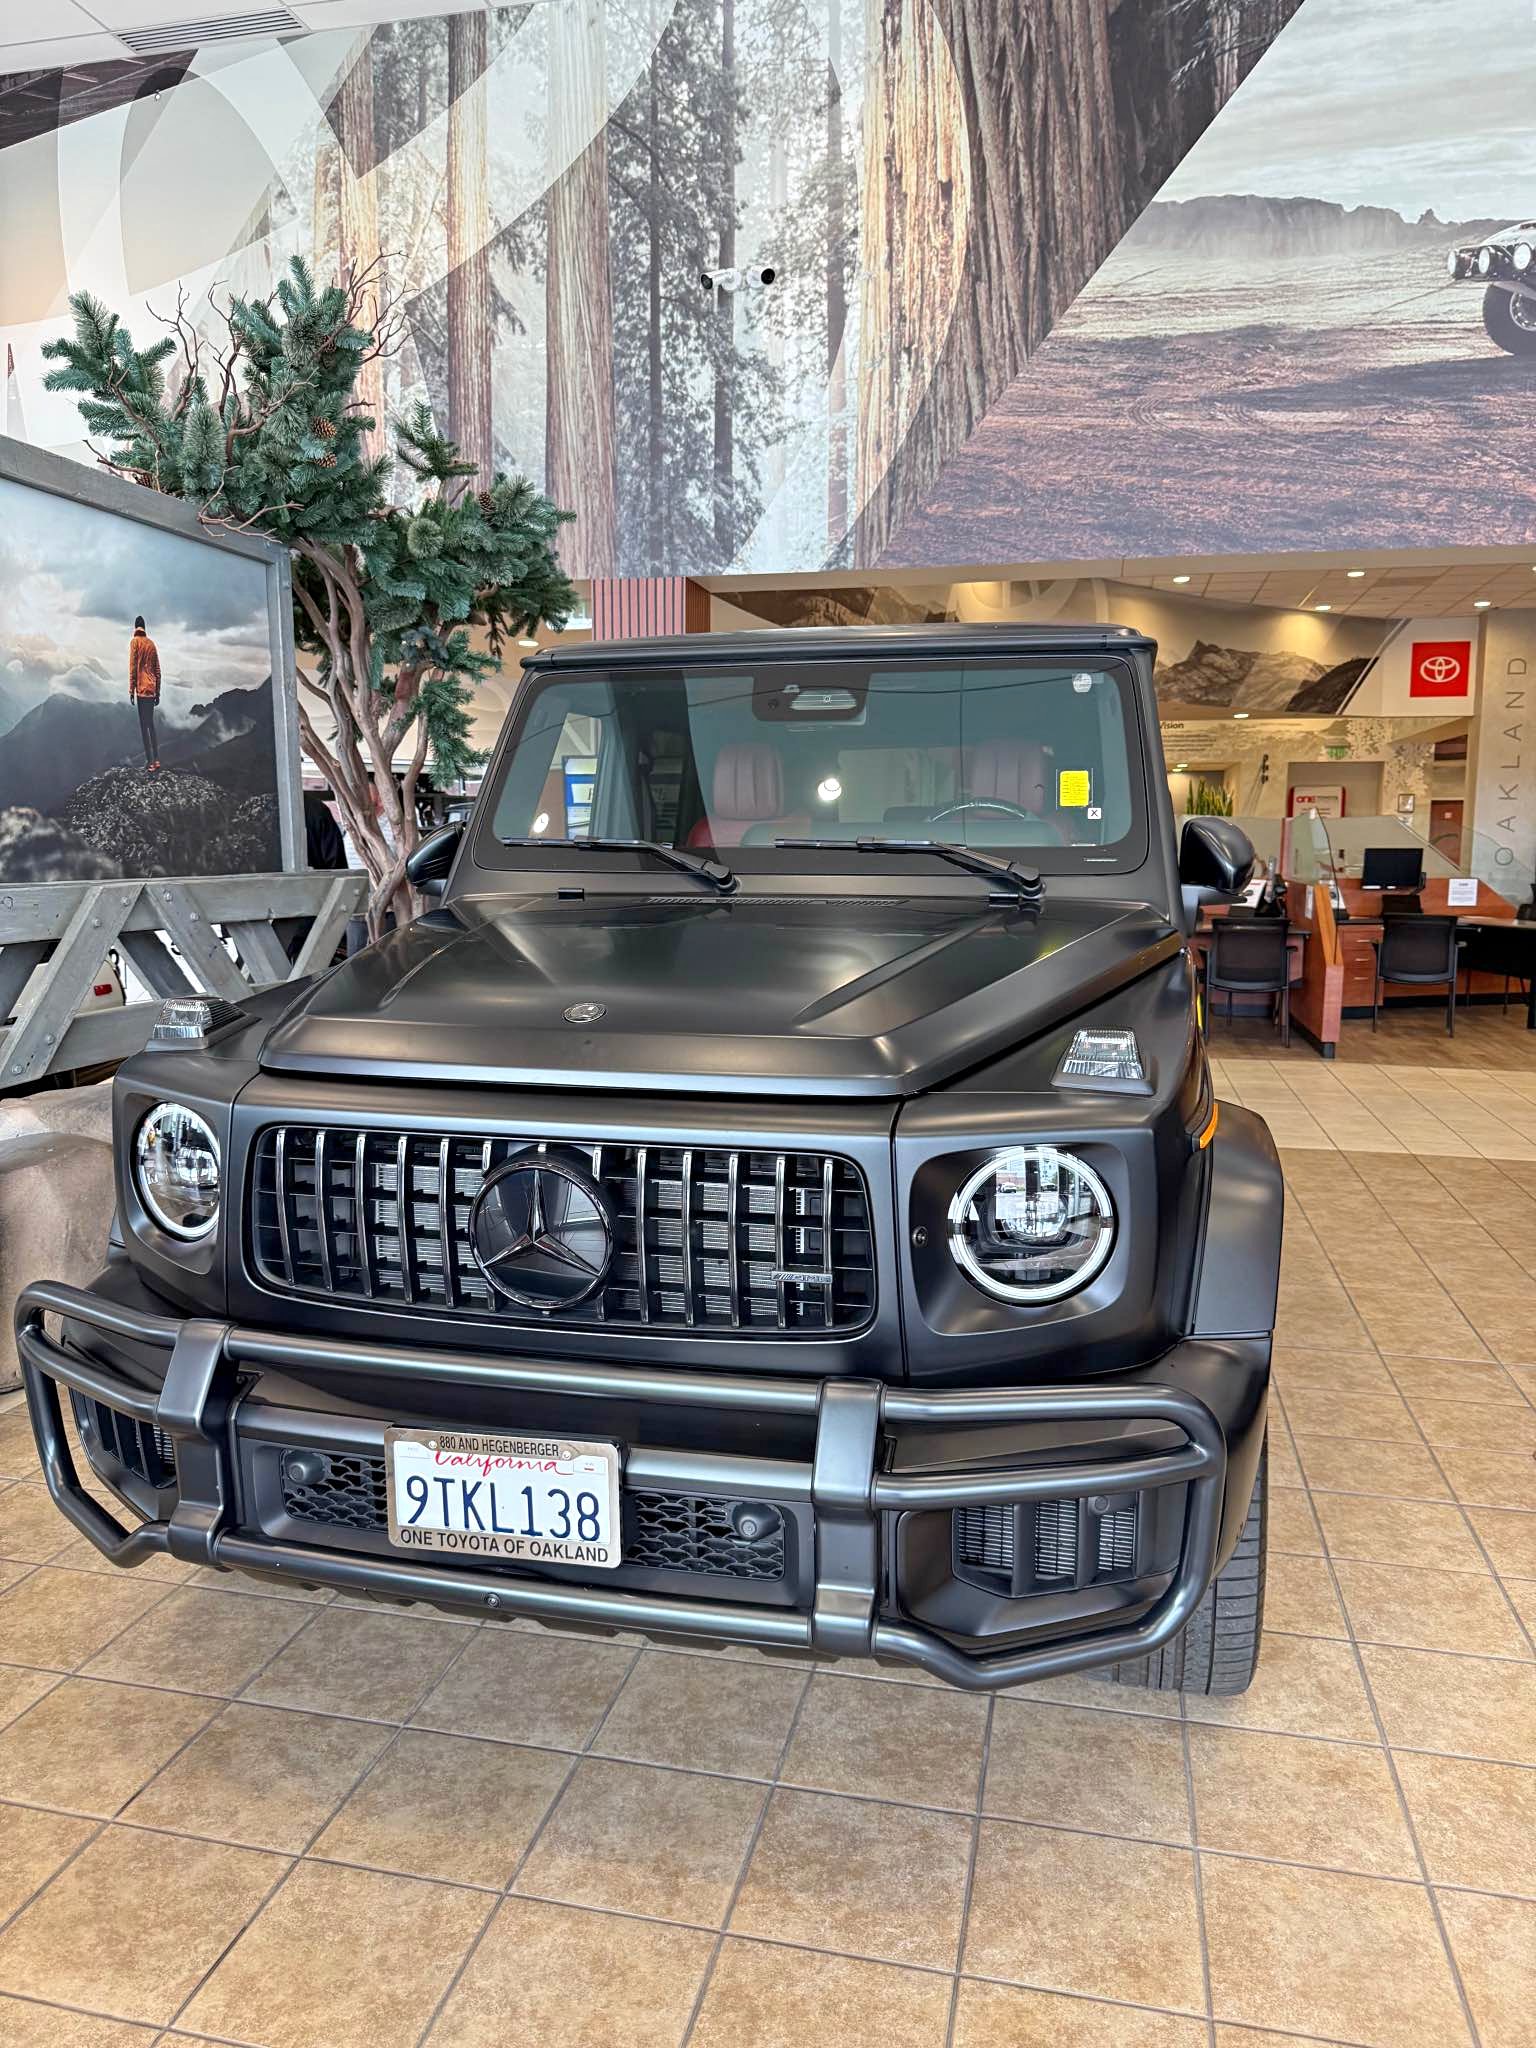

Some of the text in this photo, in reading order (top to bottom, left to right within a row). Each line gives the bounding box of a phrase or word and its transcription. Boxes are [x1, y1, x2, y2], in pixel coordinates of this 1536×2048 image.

[1494, 657, 1528, 866] OAKLAND
[439, 1435, 560, 1457] 880 AND HEGENBERGER
[406, 1475, 601, 1542] 9TKL138
[400, 1529, 609, 1563] ONE TOYOTA OF OAKLAND
